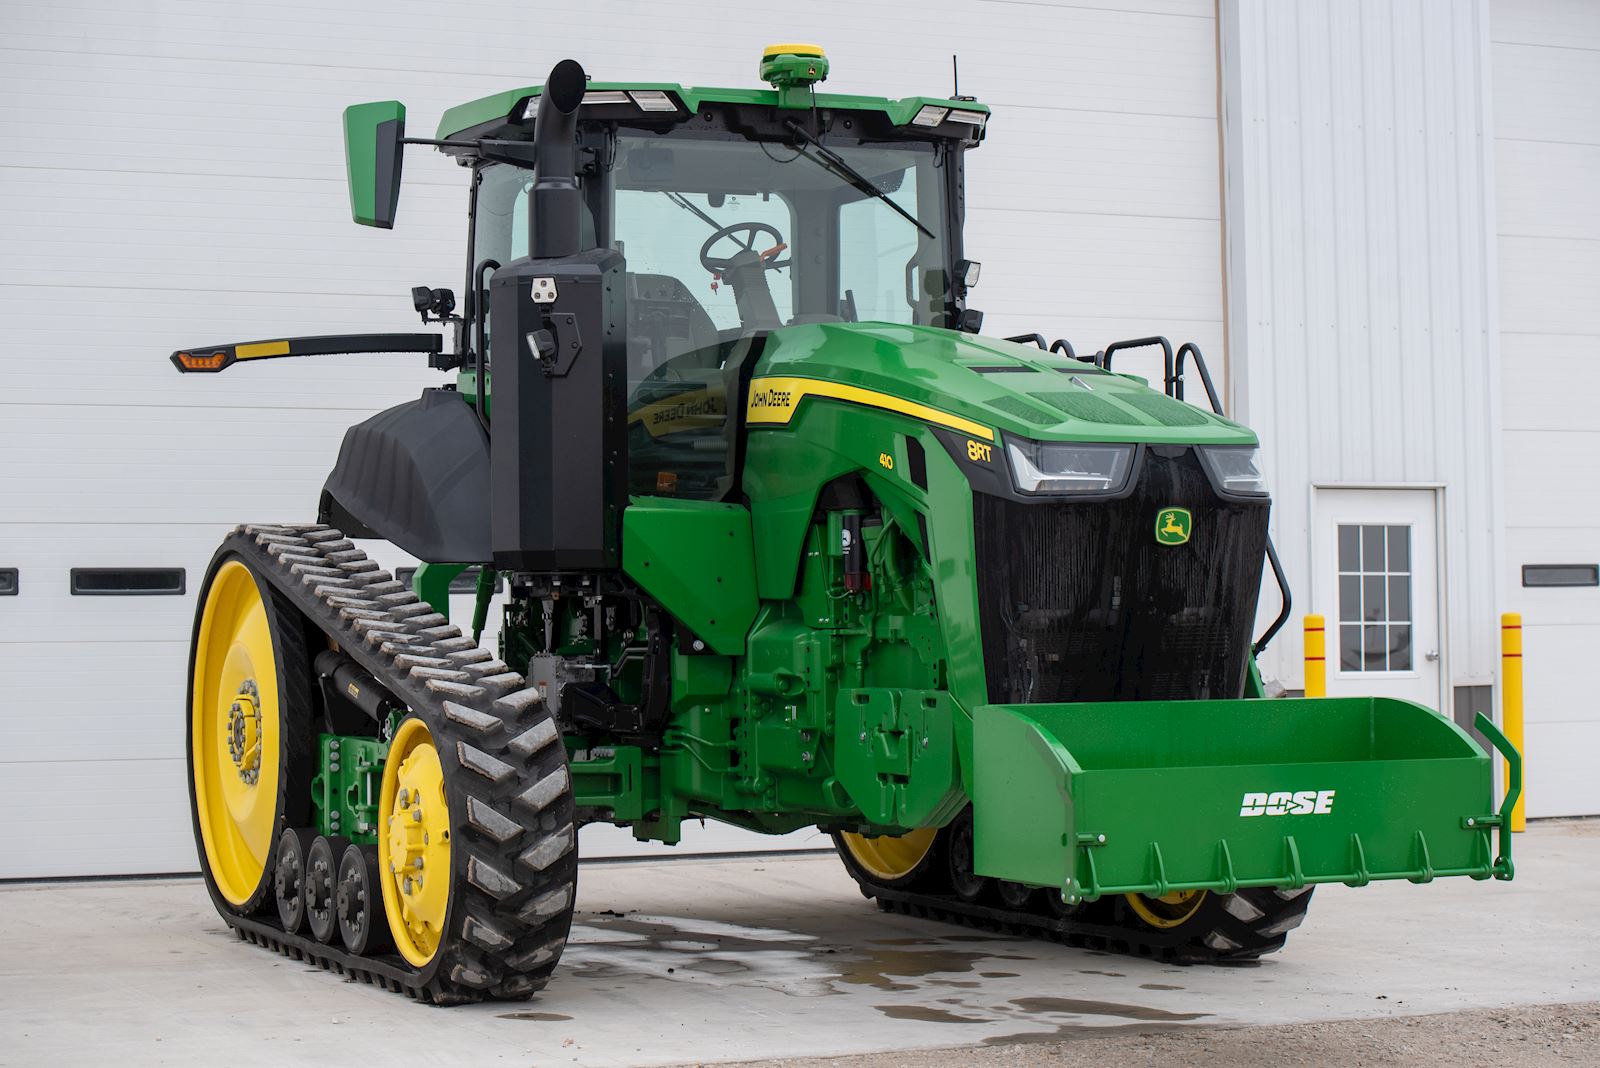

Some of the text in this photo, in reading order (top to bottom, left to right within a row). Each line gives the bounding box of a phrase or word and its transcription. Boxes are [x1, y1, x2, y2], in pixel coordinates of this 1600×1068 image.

[751, 388, 791, 408] JOHN DEERE
[880, 453, 893, 470] 410
[967, 440, 991, 462] 8RT
[1240, 790, 1336, 817] DOSE
